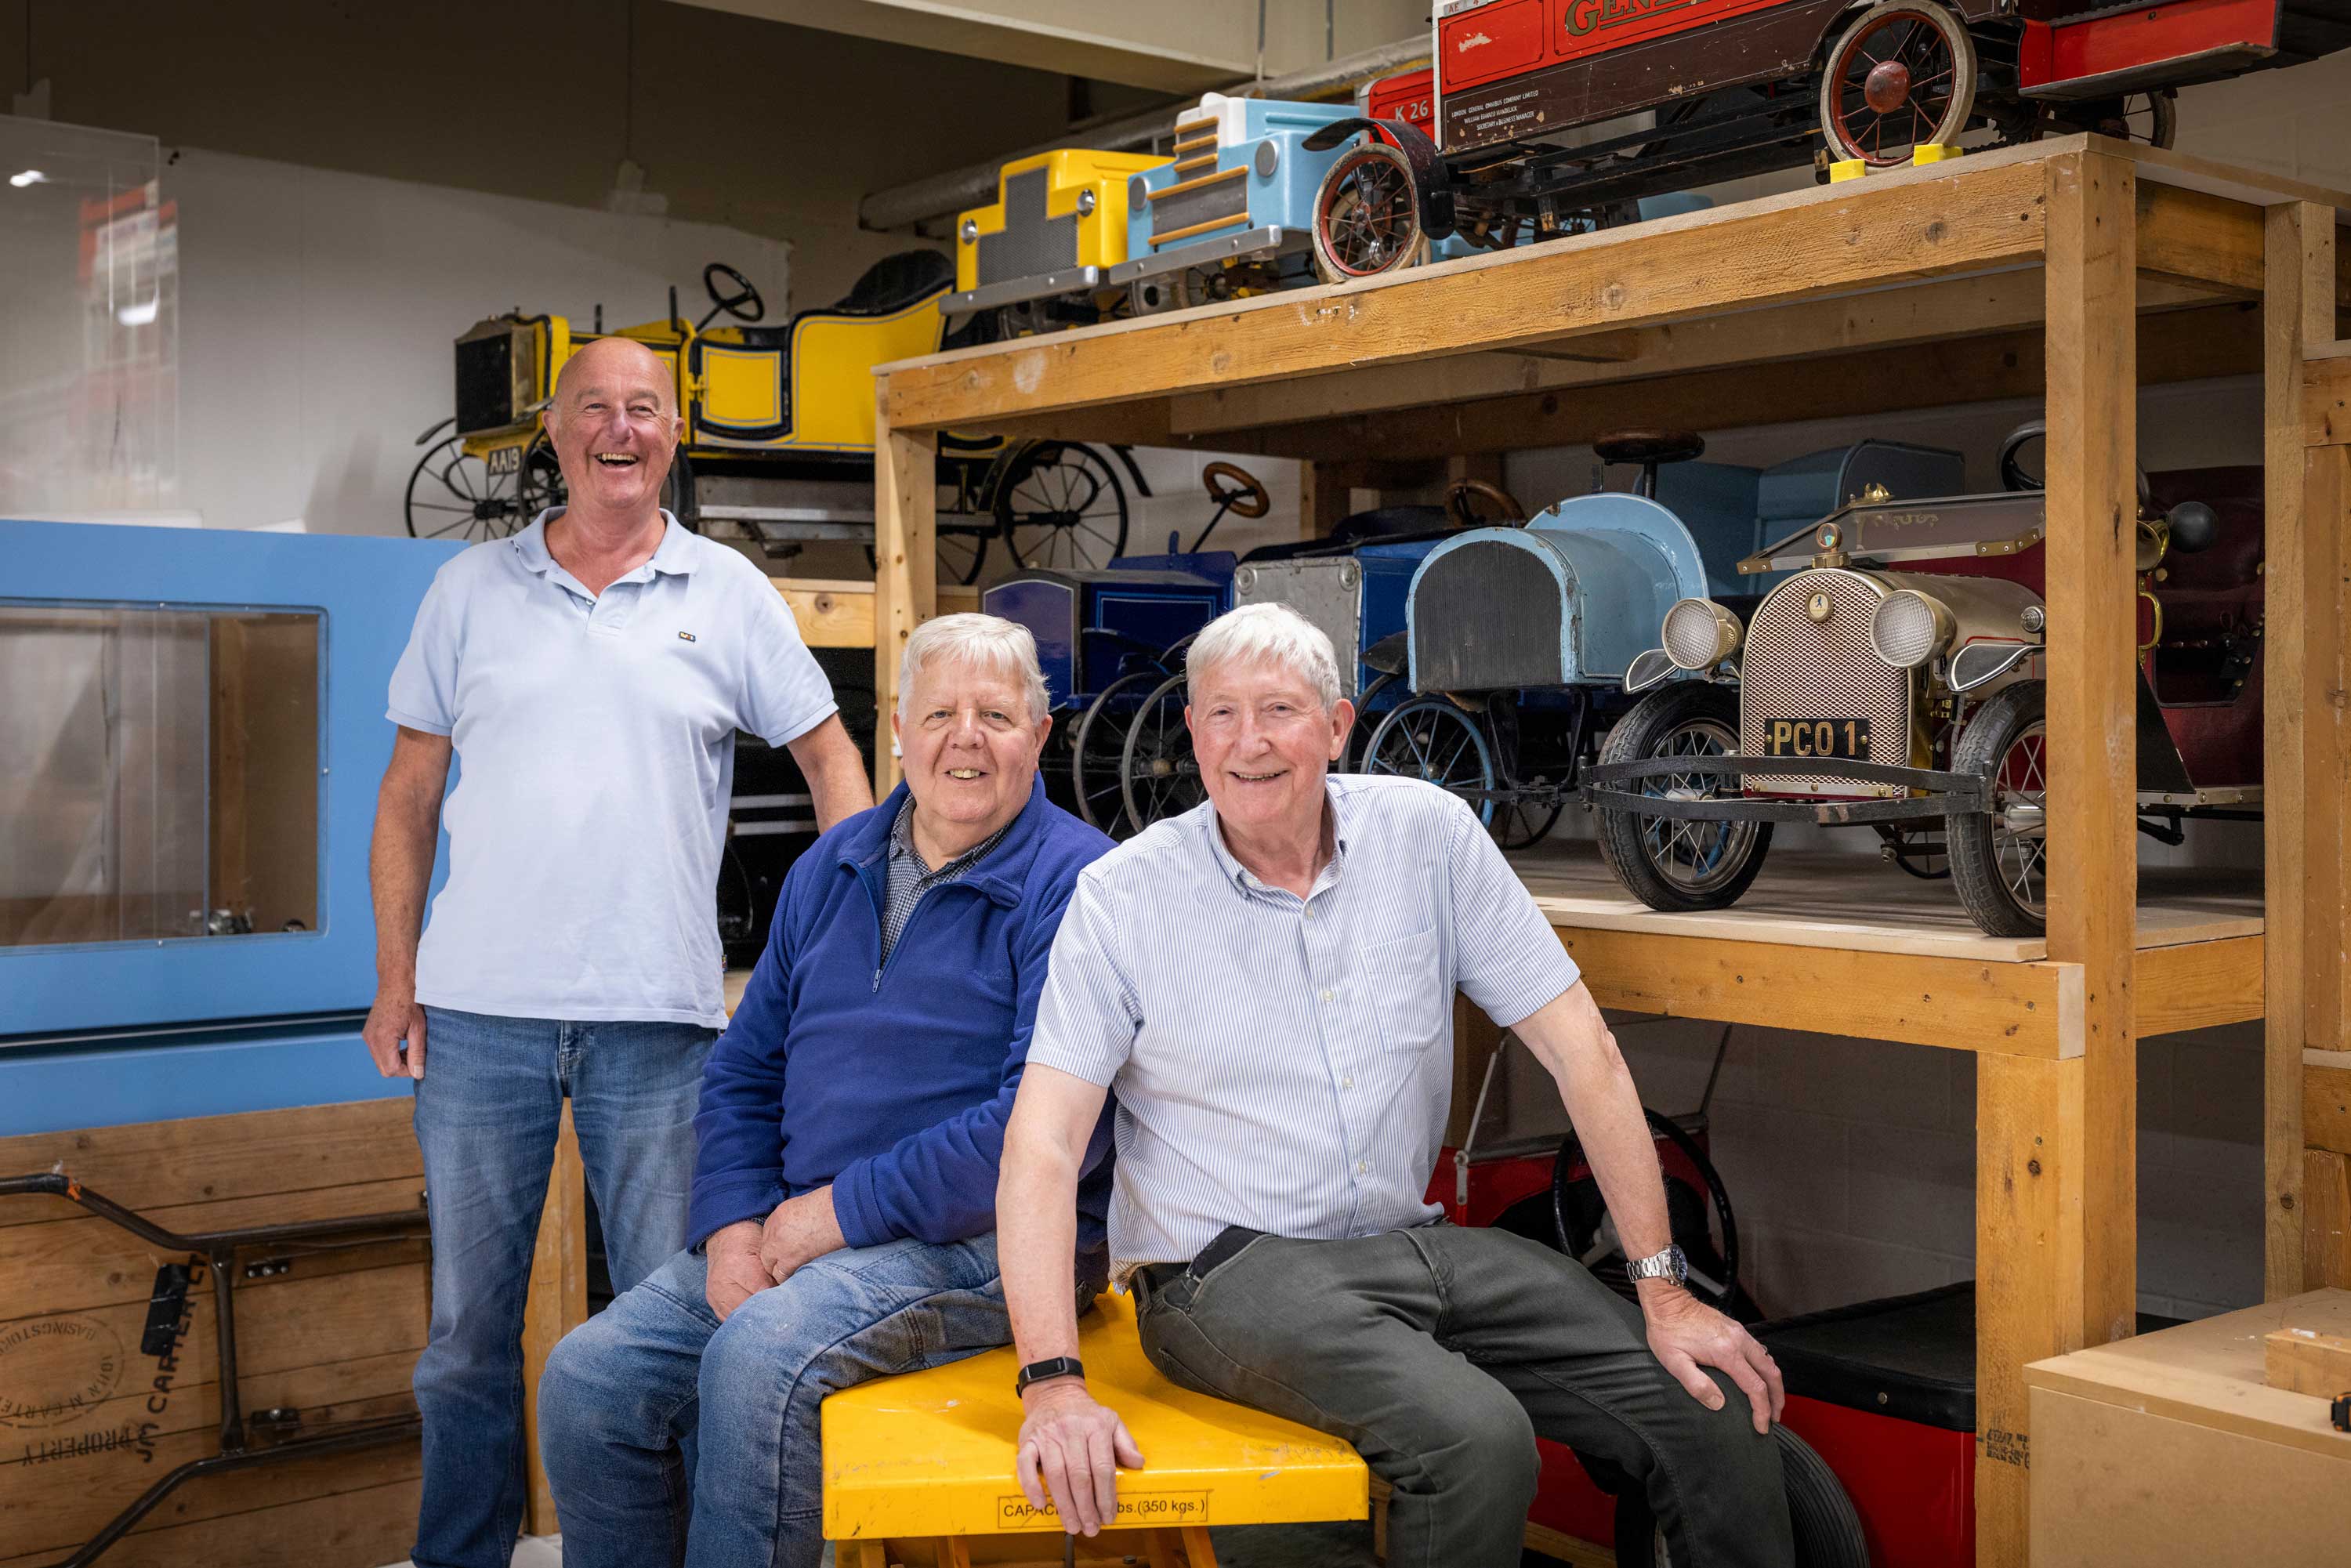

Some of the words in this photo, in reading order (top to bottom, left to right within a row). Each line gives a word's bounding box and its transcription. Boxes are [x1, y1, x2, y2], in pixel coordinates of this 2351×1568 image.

[1395, 105, 1405, 121] K
[1410, 100, 1429, 120] 26
[1451, 108, 1467, 118] LONDON
[1468, 104, 1484, 114] GENERAL
[1485, 100, 1503, 109] OMNIBUS
[1503, 95, 1522, 104] COMPANY
[1522, 89, 1538, 100] LIMITED
[1464, 115, 1480, 124] WILLIAM
[1480, 110, 1496, 120] EDWARD
[1476, 120, 1496, 131] SECRETARY
[1498, 115, 1516, 125] BUSINESS
[1516, 110, 1535, 121] MANAGER
[490, 448, 520, 473] AA19
[1773, 721, 1834, 756] PCO
[1845, 721, 1855, 755] 1
[0, 1321, 96, 1356] BASINGSTOK
[22, 1427, 132, 1466] PROPERTY
